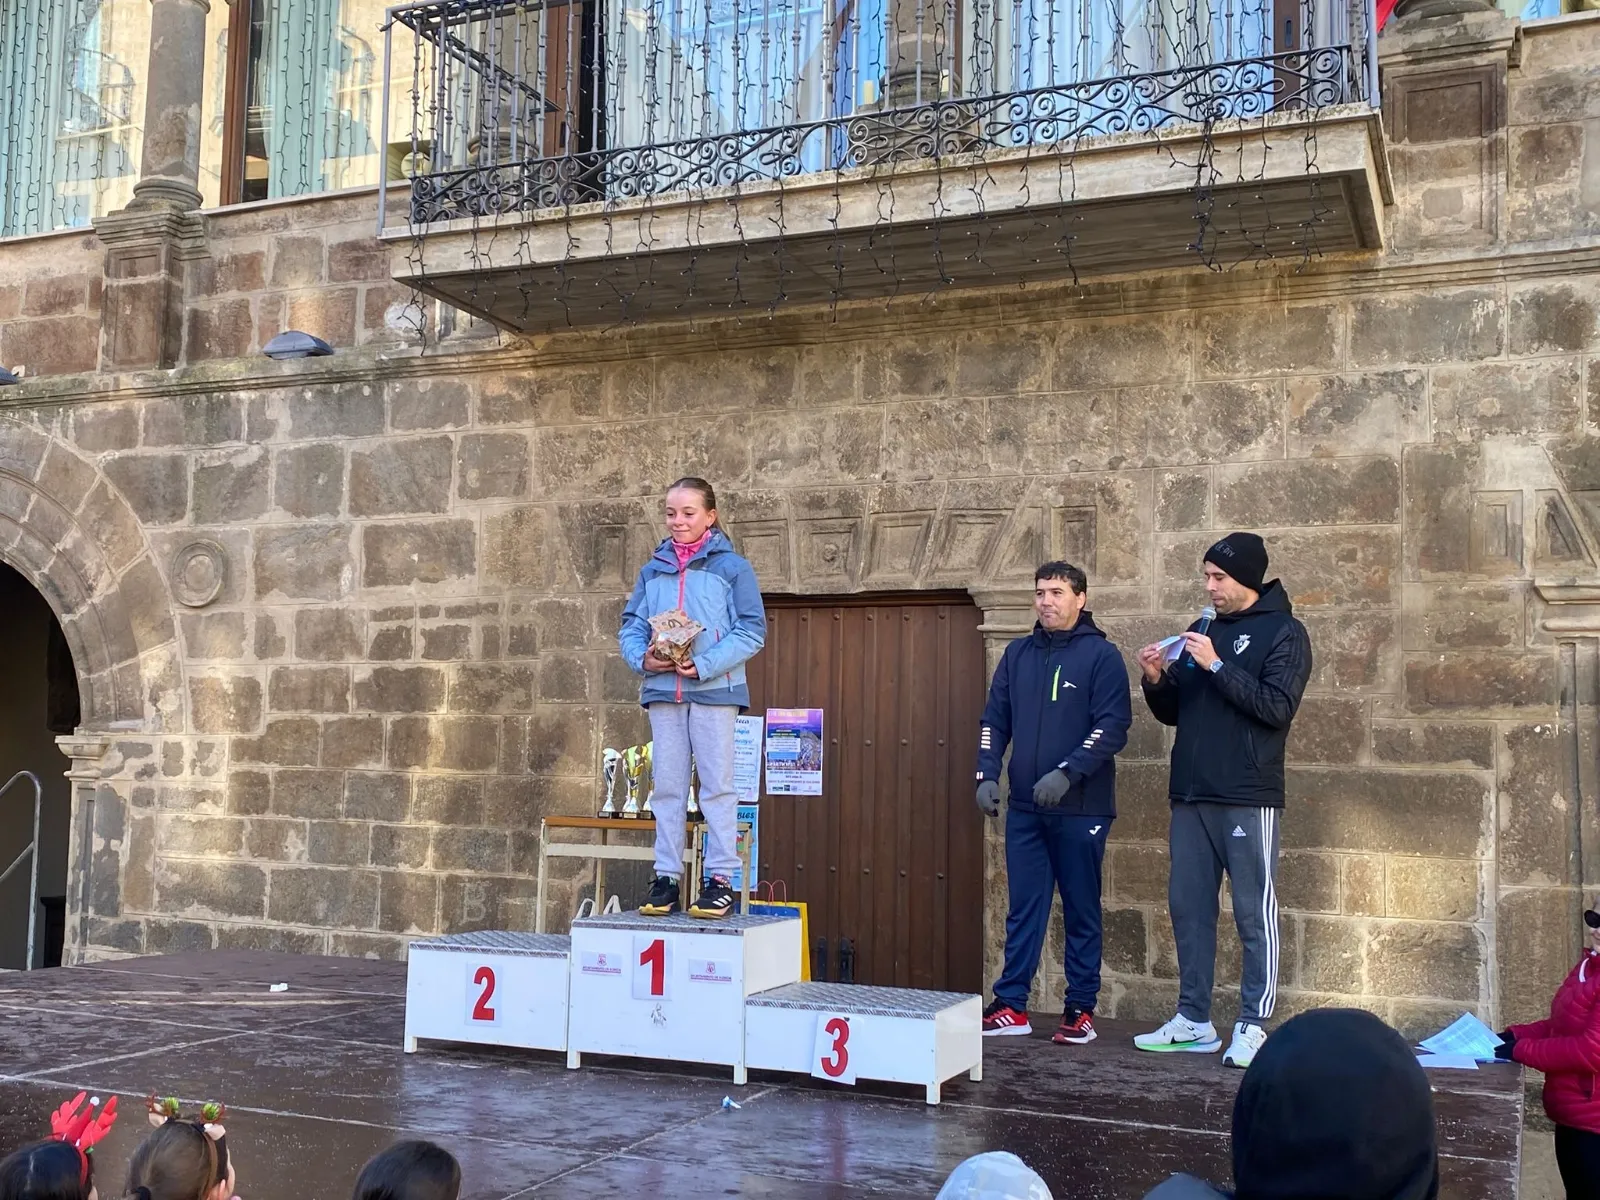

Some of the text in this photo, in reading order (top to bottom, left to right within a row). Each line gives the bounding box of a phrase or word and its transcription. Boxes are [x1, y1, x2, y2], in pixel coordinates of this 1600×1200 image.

[472, 966, 496, 1021] 2
[639, 939, 665, 996] 1
[820, 1017, 850, 1077] 3
